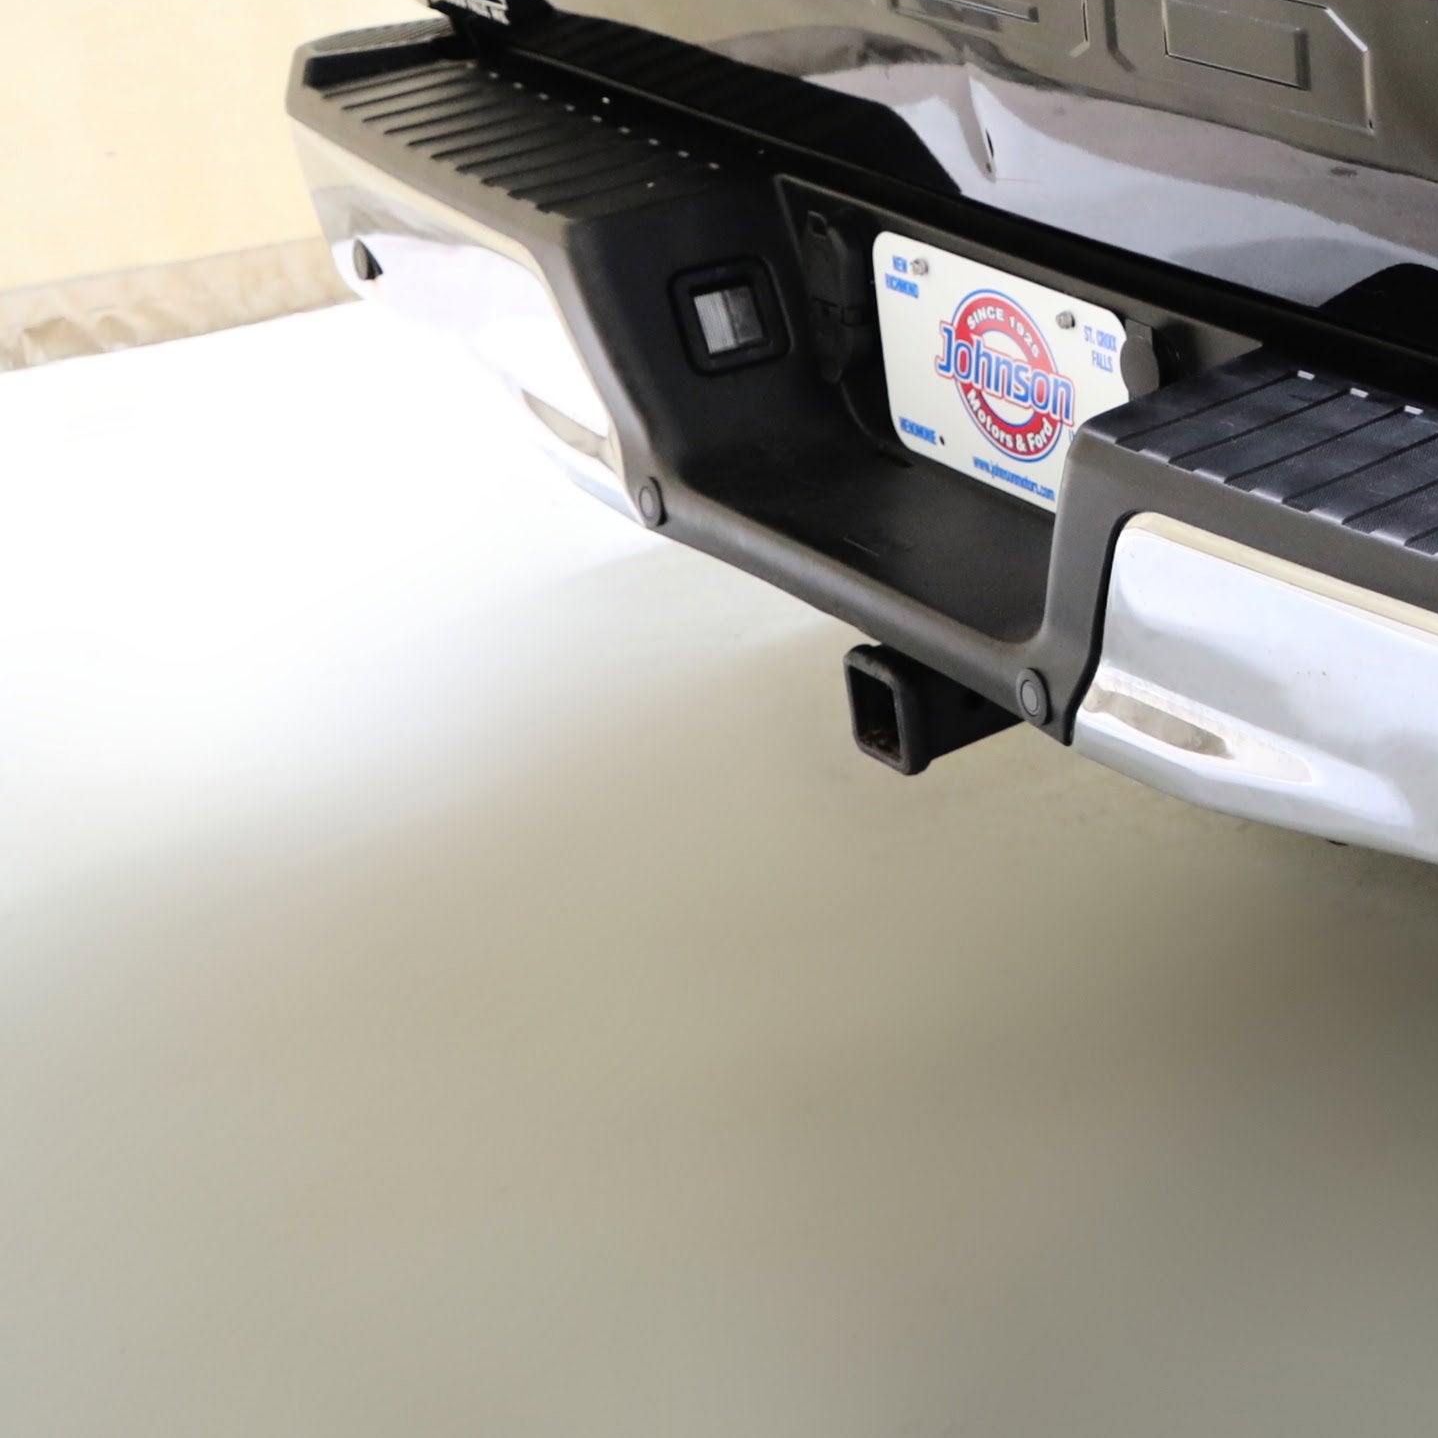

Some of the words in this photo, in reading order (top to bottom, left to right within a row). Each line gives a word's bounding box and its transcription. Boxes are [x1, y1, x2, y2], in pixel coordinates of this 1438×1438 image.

[967, 306, 1004, 330] SINCE
[938, 324, 1073, 422] Johnson
[1091, 349, 1113, 373] FALLS
[966, 388, 1014, 449] Motors
[1015, 433, 1027, 453] &
[1027, 416, 1053, 452] Ford
